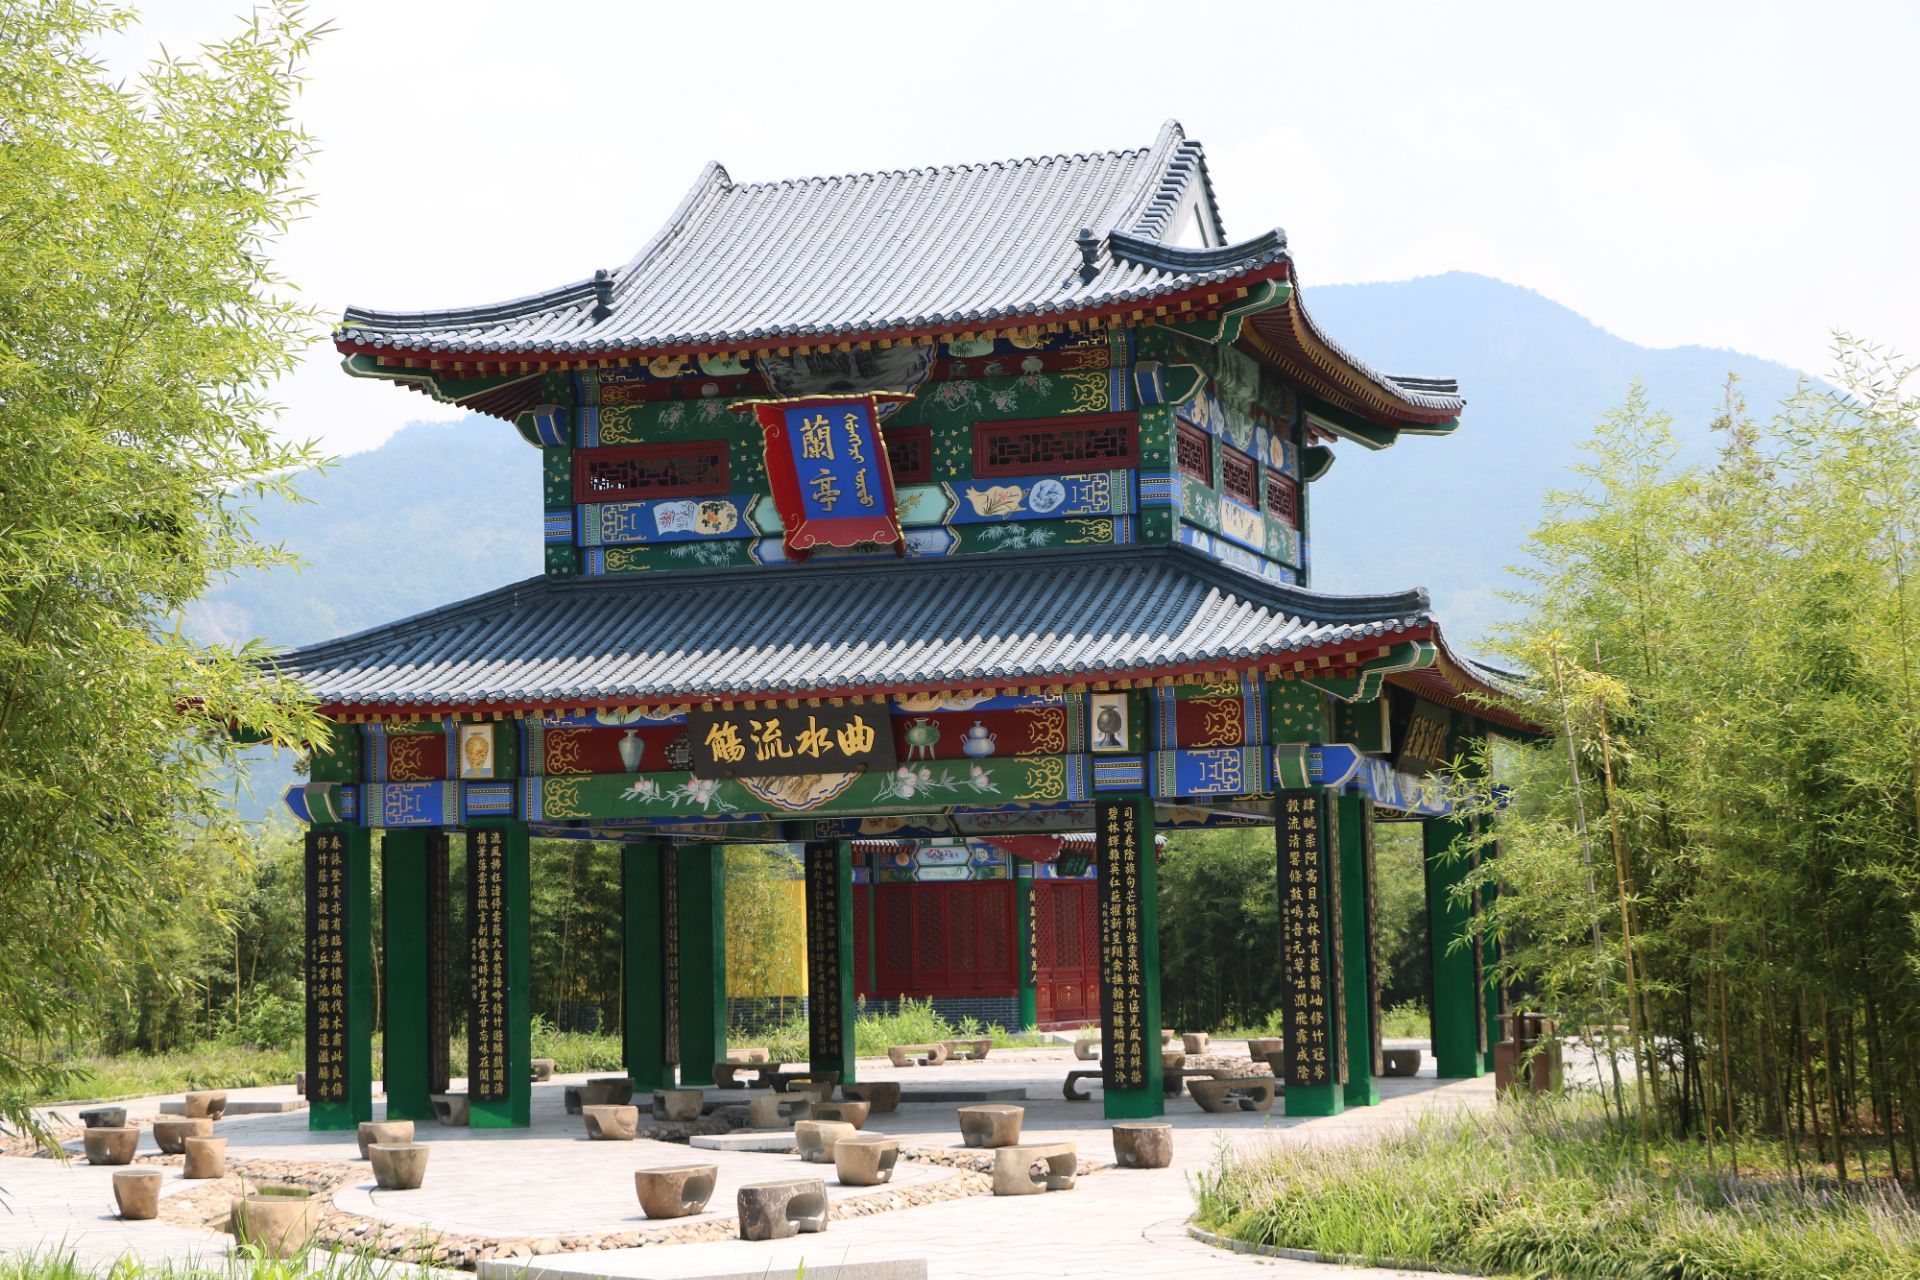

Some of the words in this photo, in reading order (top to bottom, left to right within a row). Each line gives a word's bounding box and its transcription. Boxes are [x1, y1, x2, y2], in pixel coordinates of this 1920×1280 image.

[799, 414, 841, 513] 蘭亭
[703, 714, 876, 764] 曲水流觴
